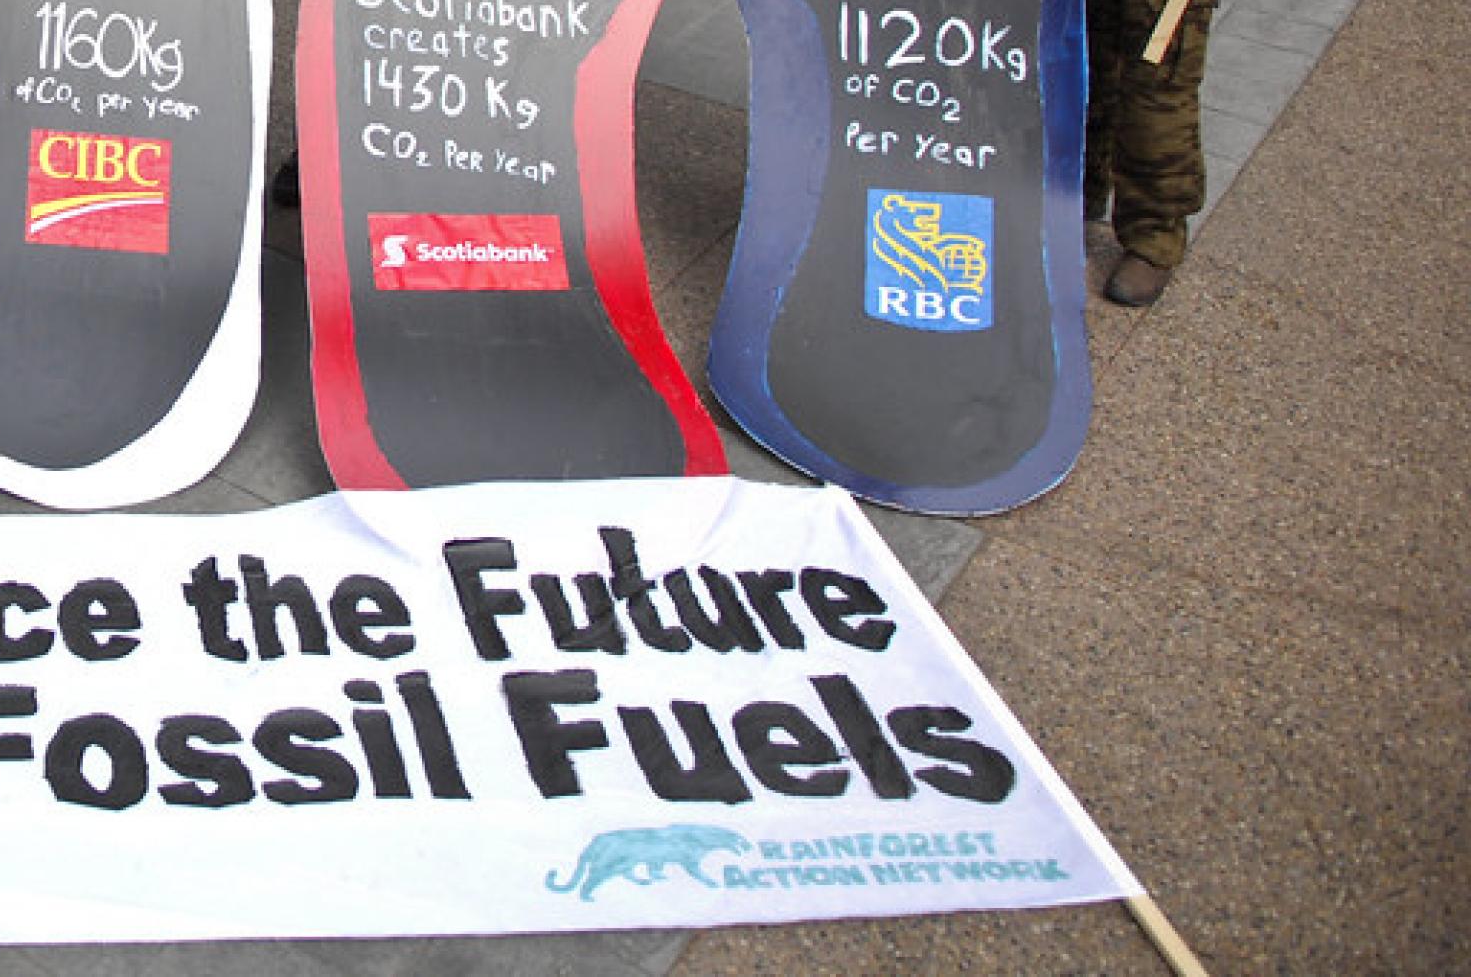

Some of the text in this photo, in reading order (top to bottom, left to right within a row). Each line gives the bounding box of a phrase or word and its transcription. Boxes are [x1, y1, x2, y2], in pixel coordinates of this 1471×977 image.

[363, 23, 509, 67] creates
[363, 57, 466, 118] 1430
[844, 72, 880, 98] of
[97, 93, 133, 118] per
[142, 96, 200, 121] year
[844, 121, 899, 154] Per
[38, 136, 161, 187] CIBC
[416, 241, 549, 262] Scotiabank
[878, 285, 982, 324] RBC
[183, 555, 414, 663] the
[442, 525, 896, 660] Future
[501, 668, 1016, 805] Fuels
[758, 831, 997, 861] RAINFOREST
[724, 859, 1071, 889] ACTION NETWORK
